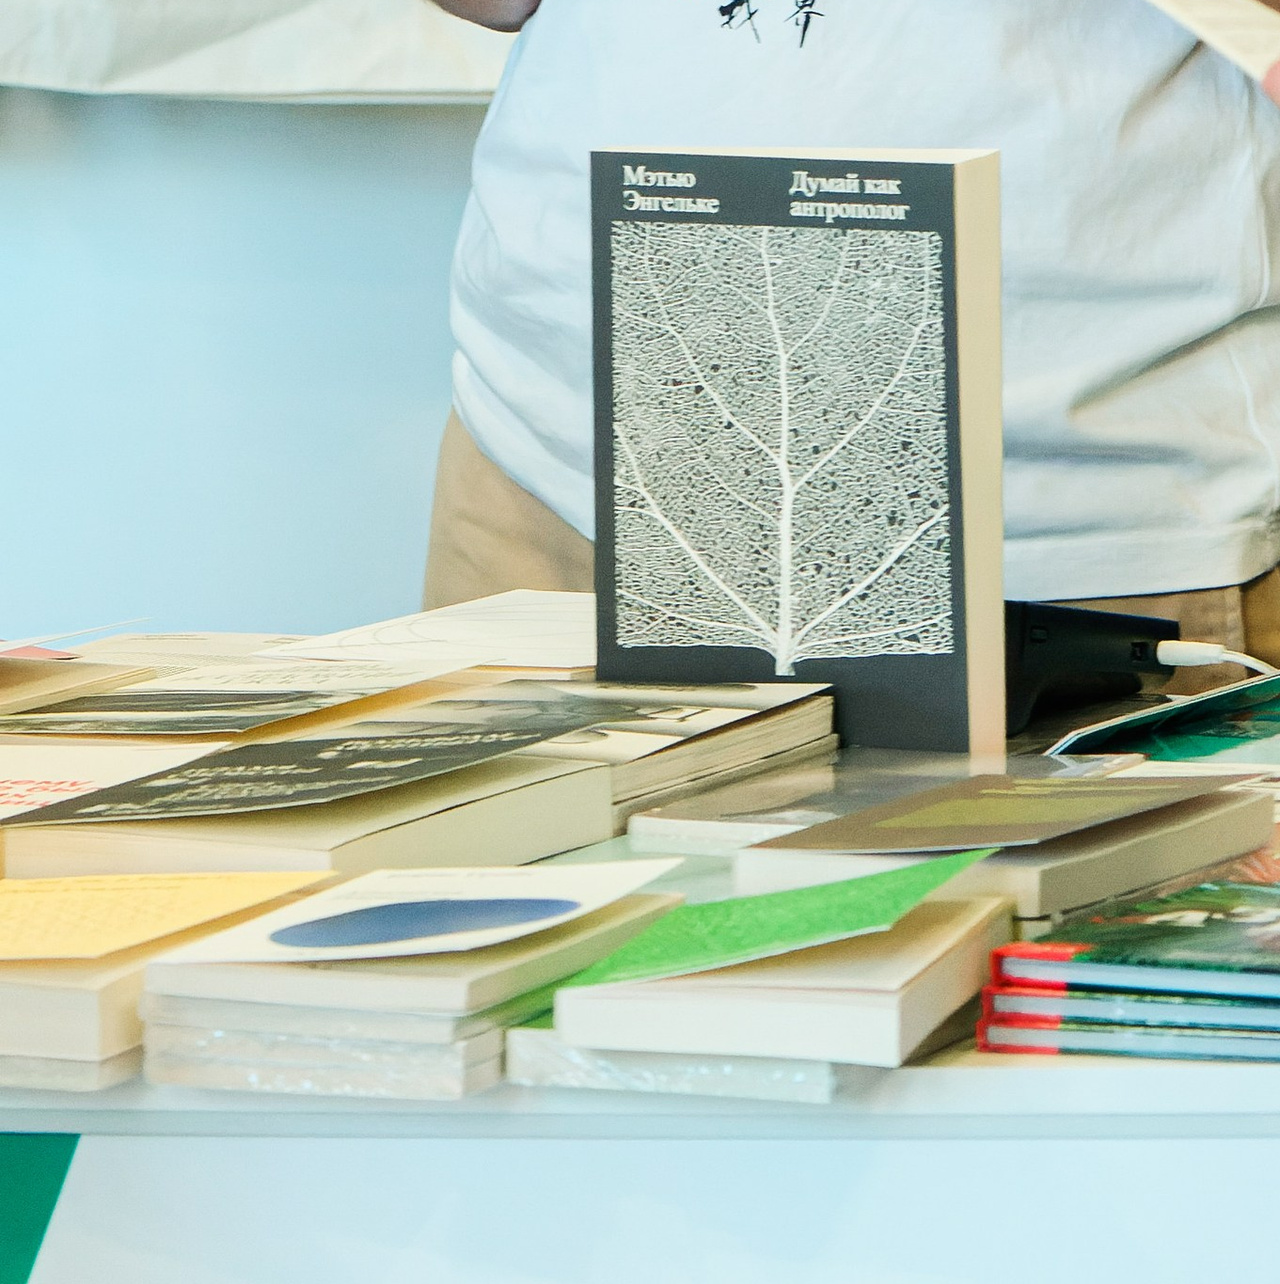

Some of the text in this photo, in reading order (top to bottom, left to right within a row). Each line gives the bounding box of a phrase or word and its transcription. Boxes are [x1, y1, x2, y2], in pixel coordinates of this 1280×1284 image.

[621, 164, 698, 189] Мэтью
[787, 170, 903, 198] Думай как
[621, 189, 721, 215] Энгельке
[788, 200, 912, 224] антрополог
